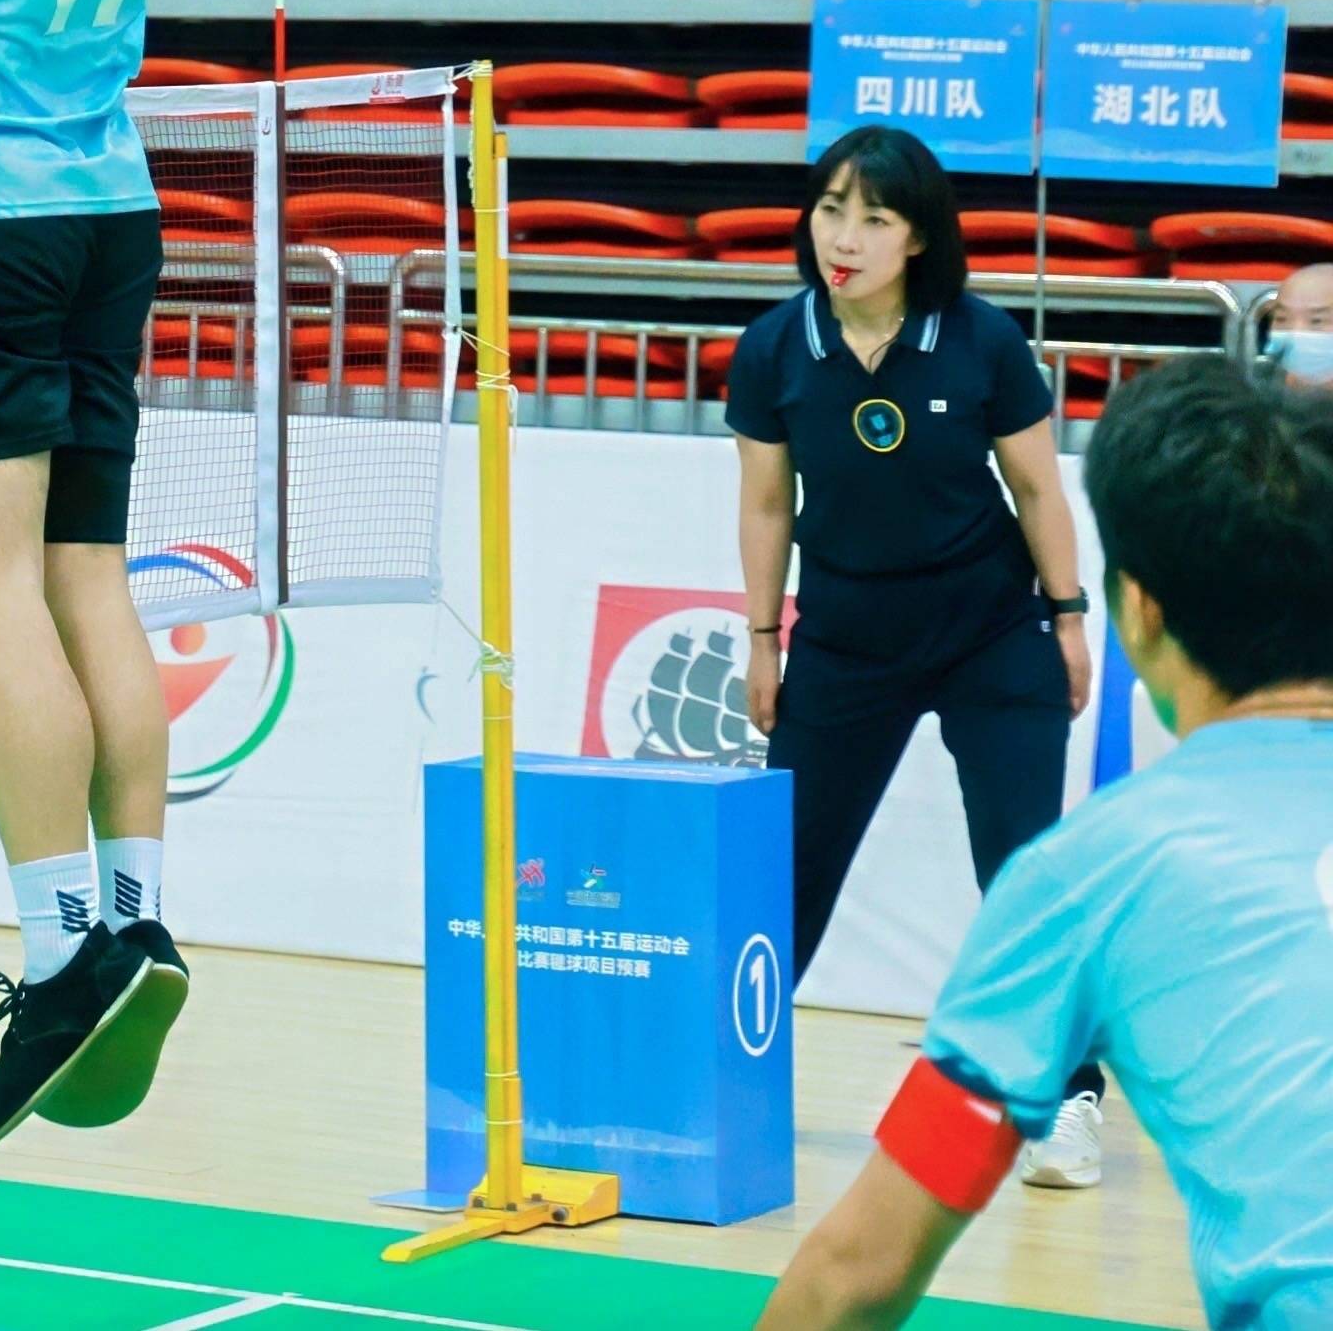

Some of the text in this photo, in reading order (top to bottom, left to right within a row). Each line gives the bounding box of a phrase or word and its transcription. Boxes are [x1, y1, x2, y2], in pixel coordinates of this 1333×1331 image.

[855, 76, 984, 118] 四川队
[1092, 83, 1227, 129] 湖北队
[447, 917, 691, 956] 中华共和国第十五届运动会
